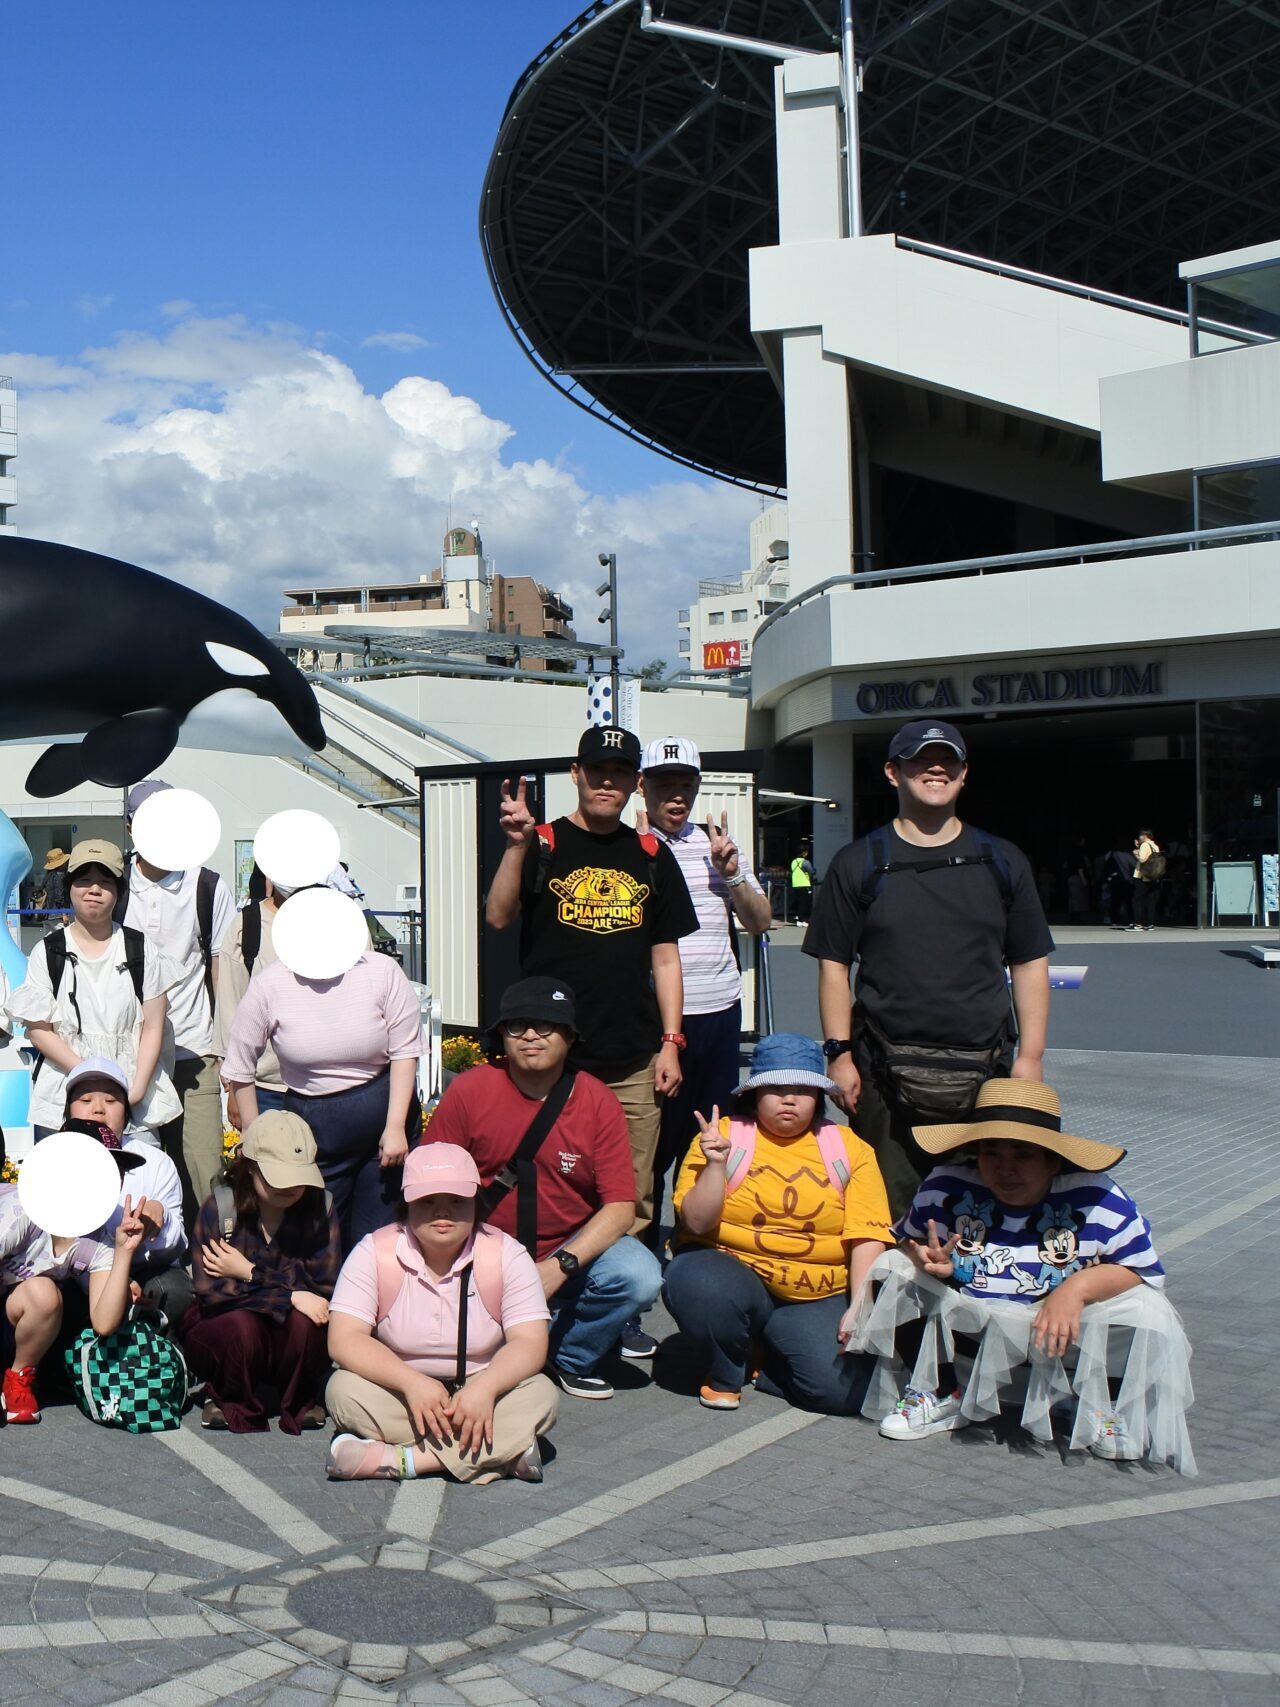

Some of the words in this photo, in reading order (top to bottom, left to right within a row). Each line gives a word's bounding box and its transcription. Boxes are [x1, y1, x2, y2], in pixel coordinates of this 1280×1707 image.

[856, 677, 954, 714] ORCA
[970, 661, 1162, 706] STADIUM
[561, 902, 641, 924] CHAMPIONS
[750, 1259, 835, 1293] GIAN
